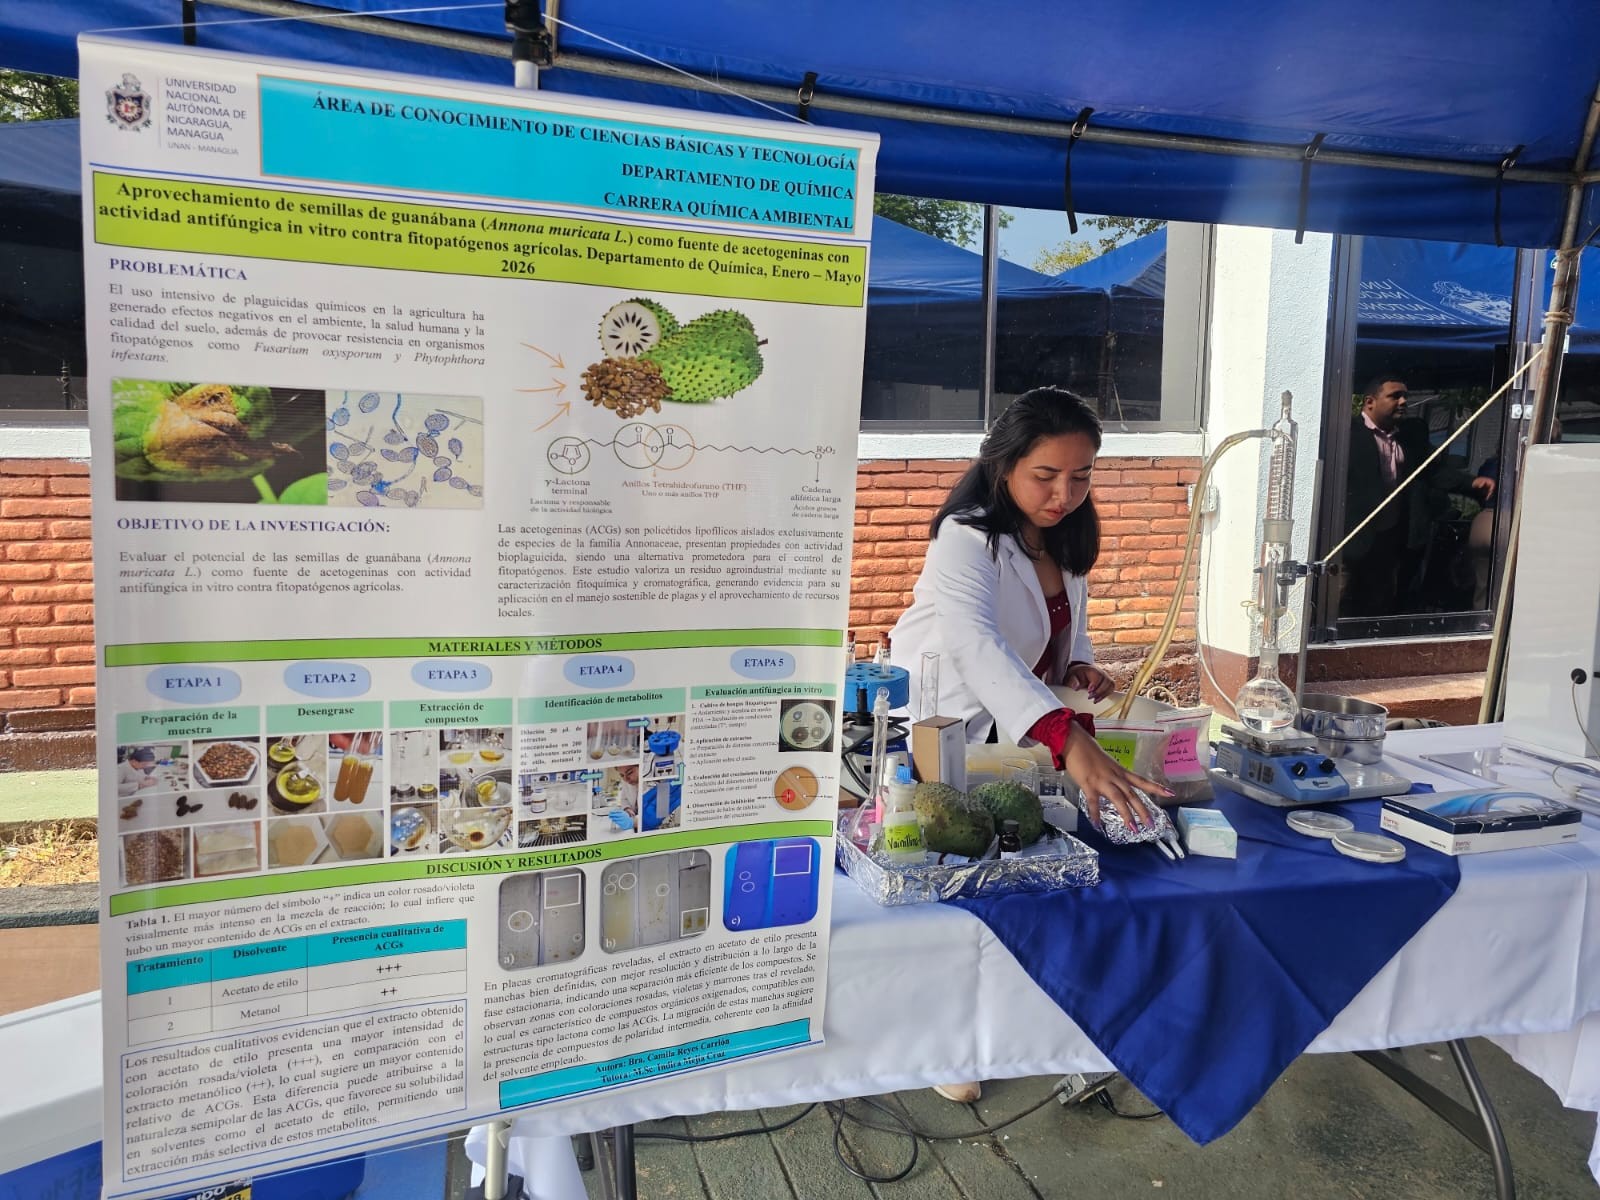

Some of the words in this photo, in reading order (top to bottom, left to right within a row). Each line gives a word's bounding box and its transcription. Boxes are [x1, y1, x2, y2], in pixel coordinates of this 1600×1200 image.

[164, 77, 236, 94] UNIVERSIDAD
[165, 89, 222, 104] NACIONAL
[166, 102, 230, 118] AUTÓNOMA
[232, 109, 246, 119] DE
[166, 114, 232, 130] NICARAGUA,
[167, 126, 224, 141] MANAGUA
[313, 91, 366, 114] ÁREA
[371, 102, 395, 118] DE
[401, 106, 548, 135] CONOCIMIENTO
[552, 123, 575, 138] DE
[580, 127, 660, 149] CIENCIAS
[665, 130, 733, 157] BÁSICAS
[737, 145, 748, 158] Y
[751, 146, 855, 171] TECNOLOGÍA
[621, 162, 755, 190] DEPARTAMENTO
[759, 178, 780, 192] DE
[784, 179, 854, 199] QUÍMICA
[603, 192, 684, 212] CARRERA
[687, 199, 759, 220] QUÍMICA
[761, 209, 853, 229] AMBIENTAL
[117, 182, 270, 209] Aprovechamiento
[275, 197, 294, 211] de
[299, 202, 363, 218] semillas
[368, 206, 386, 220] de
[391, 211, 476, 228] guanábana
[480, 217, 544, 234] (Annona
[548, 225, 610, 241] muricata
[613, 229, 633, 246] L.)
[636, 235, 673, 247] como
[677, 236, 719, 252] fuente
[722, 240, 738, 254] de
[742, 245, 823, 261] acetogeninas
[827, 253, 849, 263] con
[98, 204, 180, 223] actividad
[186, 213, 282, 233] antifúngica
[287, 219, 302, 234] in
[308, 222, 346, 238] vitro
[351, 229, 402, 243] contra
[407, 231, 508, 252] fitopatógenos
[513, 241, 582, 258] agrícolas.
[586, 246, 684, 268] Departamento
[688, 257, 704, 270] de
[708, 259, 767, 277] Química,
[772, 264, 810, 279] Enero
[825, 269, 861, 286] Mayo
[110, 258, 247, 280] PROBLEMÁTICA
[501, 259, 535, 274] 2026
[109, 283, 122, 295] El
[131, 288, 152, 297] uso
[161, 288, 215, 302] intensivo
[222, 292, 236, 303] de
[243, 294, 308, 309] plaguicidas
[315, 300, 366, 313] químicos
[372, 306, 386, 315] en
[392, 304, 403, 315] la
[409, 307, 466, 320] agricultura
[472, 310, 485, 320] ha
[116, 518, 204, 530] OBJETIVO
[209, 519, 230, 530] DE
[236, 519, 256, 530] LA
[260, 518, 390, 532] INVESTIGACIÓN:
[119, 581, 188, 595] antifúngica
[191, 583, 202, 592] in
[206, 582, 234, 591] vitro
[236, 583, 272, 592] contra
[276, 581, 350, 594] fitopatógenos
[352, 580, 404, 594] agrícolas.
[498, 607, 534, 617] locales.
[428, 641, 520, 652] MATERIALES
[524, 641, 533, 651] Y
[537, 638, 602, 650] MÉTODOS
[580, 665, 615, 675] ETAPA
[616, 664, 622, 672] 4
[744, 658, 776, 667] ETAPA
[778, 658, 784, 666] 5
[304, 673, 346, 684] ETAPA
[350, 672, 356, 682] 2
[428, 669, 468, 679] ETAPA
[470, 669, 476, 679] 3
[165, 677, 212, 688] ETAPA
[216, 676, 220, 686] 1
[420, 702, 470, 712] Extracción
[472, 702, 484, 710] de
[544, 696, 603, 708] Identificación
[604, 695, 615, 703] de
[616, 692, 663, 703] metabolitos
[140, 711, 208, 725] Preparación
[211, 711, 224, 719] de
[227, 710, 237, 719] la
[297, 707, 354, 717] Desengrase
[424, 715, 479, 726] compuestos
[167, 726, 212, 735] muestra
[424, 857, 502, 874] DISCUSIÓN
[505, 858, 514, 868] Y
[518, 848, 602, 868] RESULTADOS
[332, 931, 378, 944] Presencia
[380, 924, 431, 938] cualitativa
[432, 924, 444, 932] de
[232, 944, 287, 958] Disolvente
[375, 940, 404, 951] ACGs
[135, 956, 204, 973] Tratamiento
[376, 963, 402, 973] +++
[221, 985, 260, 997] Acetato
[262, 981, 274, 990] de
[276, 977, 298, 988] etilo
[380, 986, 397, 996] ++
[168, 996, 172, 1005] 1
[240, 1004, 280, 1019] Metanol
[167, 1021, 174, 1031] 2
[125, 1057, 148, 1069] Los
[151, 1045, 210, 1063] resultados
[213, 1034, 278, 1052] cualitativos
[281, 1023, 340, 1040] evidencian
[342, 1021, 362, 1032] que
[364, 1015, 374, 1027] el
[376, 1011, 418, 1028] extracto
[421, 1004, 464, 1017] obtenido
